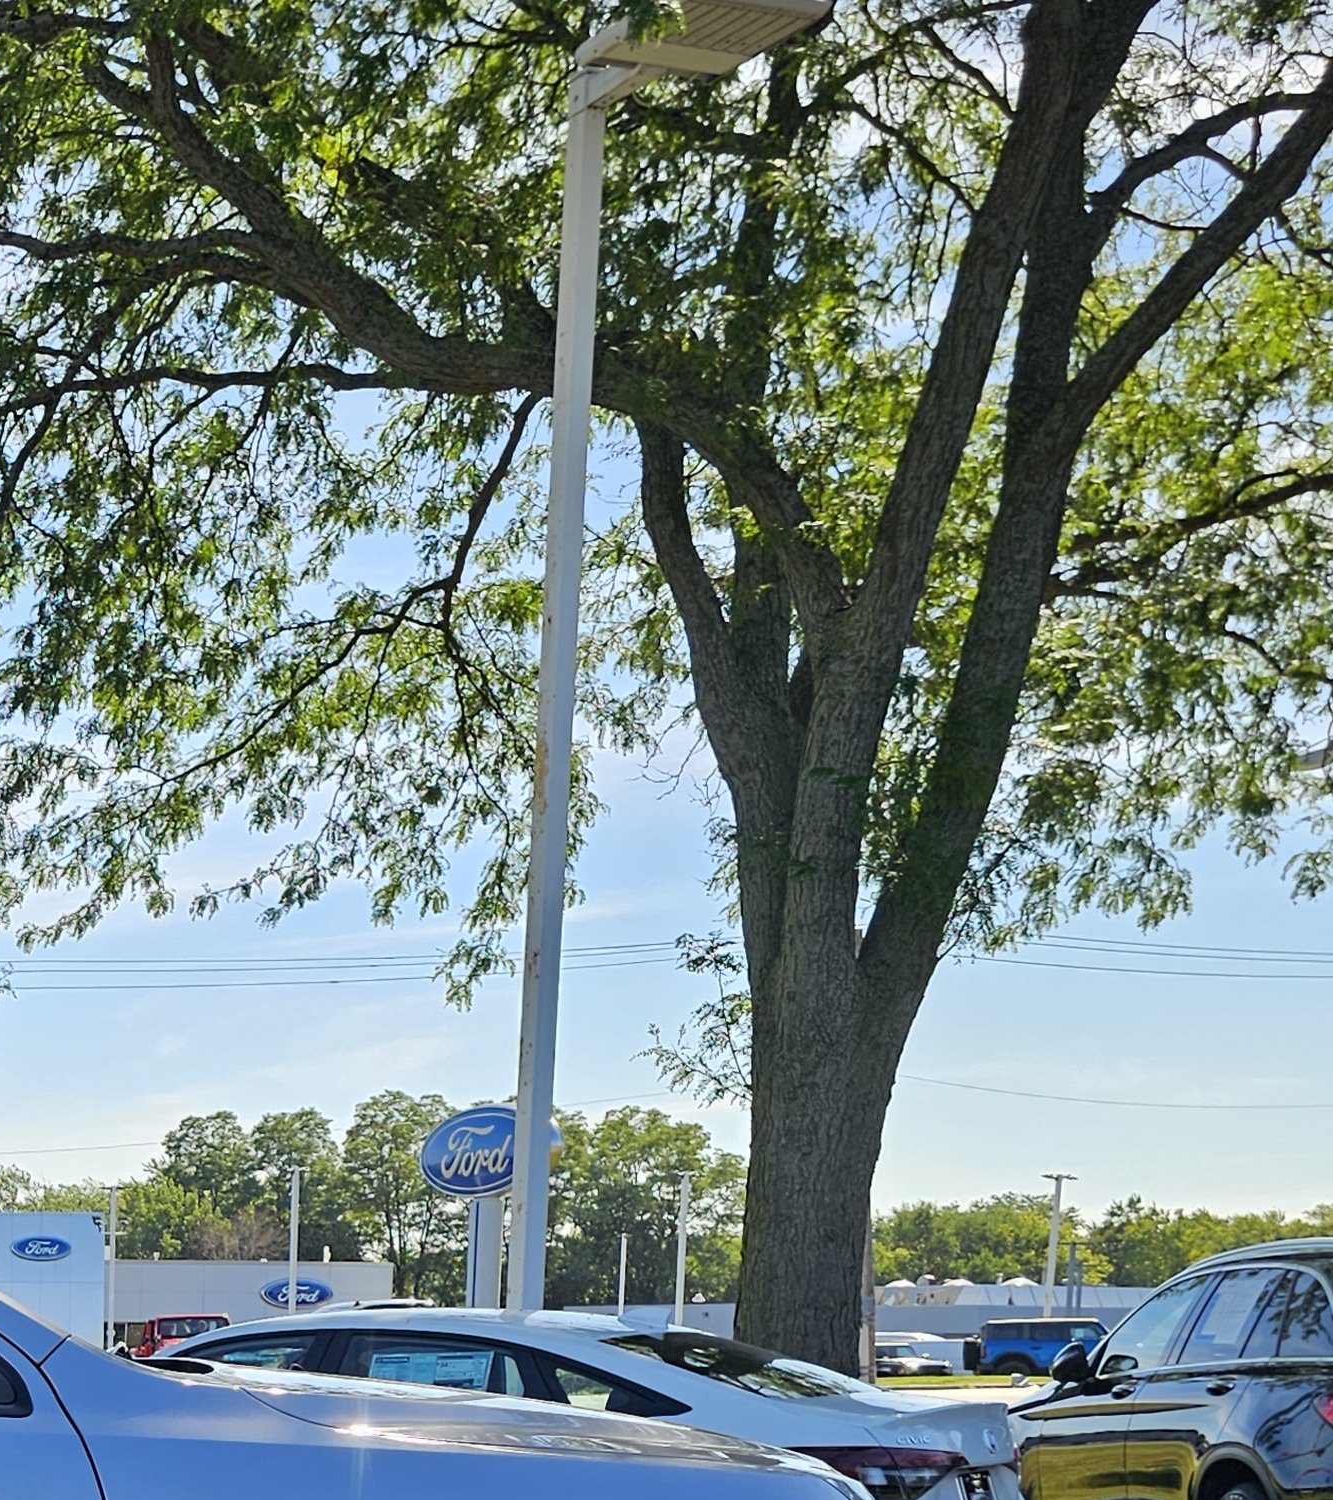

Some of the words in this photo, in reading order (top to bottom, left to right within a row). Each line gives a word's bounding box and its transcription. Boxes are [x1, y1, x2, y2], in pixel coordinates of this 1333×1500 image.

[440, 1125, 512, 1179] Ford
[25, 1240, 59, 1255] Ford
[896, 1436, 931, 1445] CIVIC
